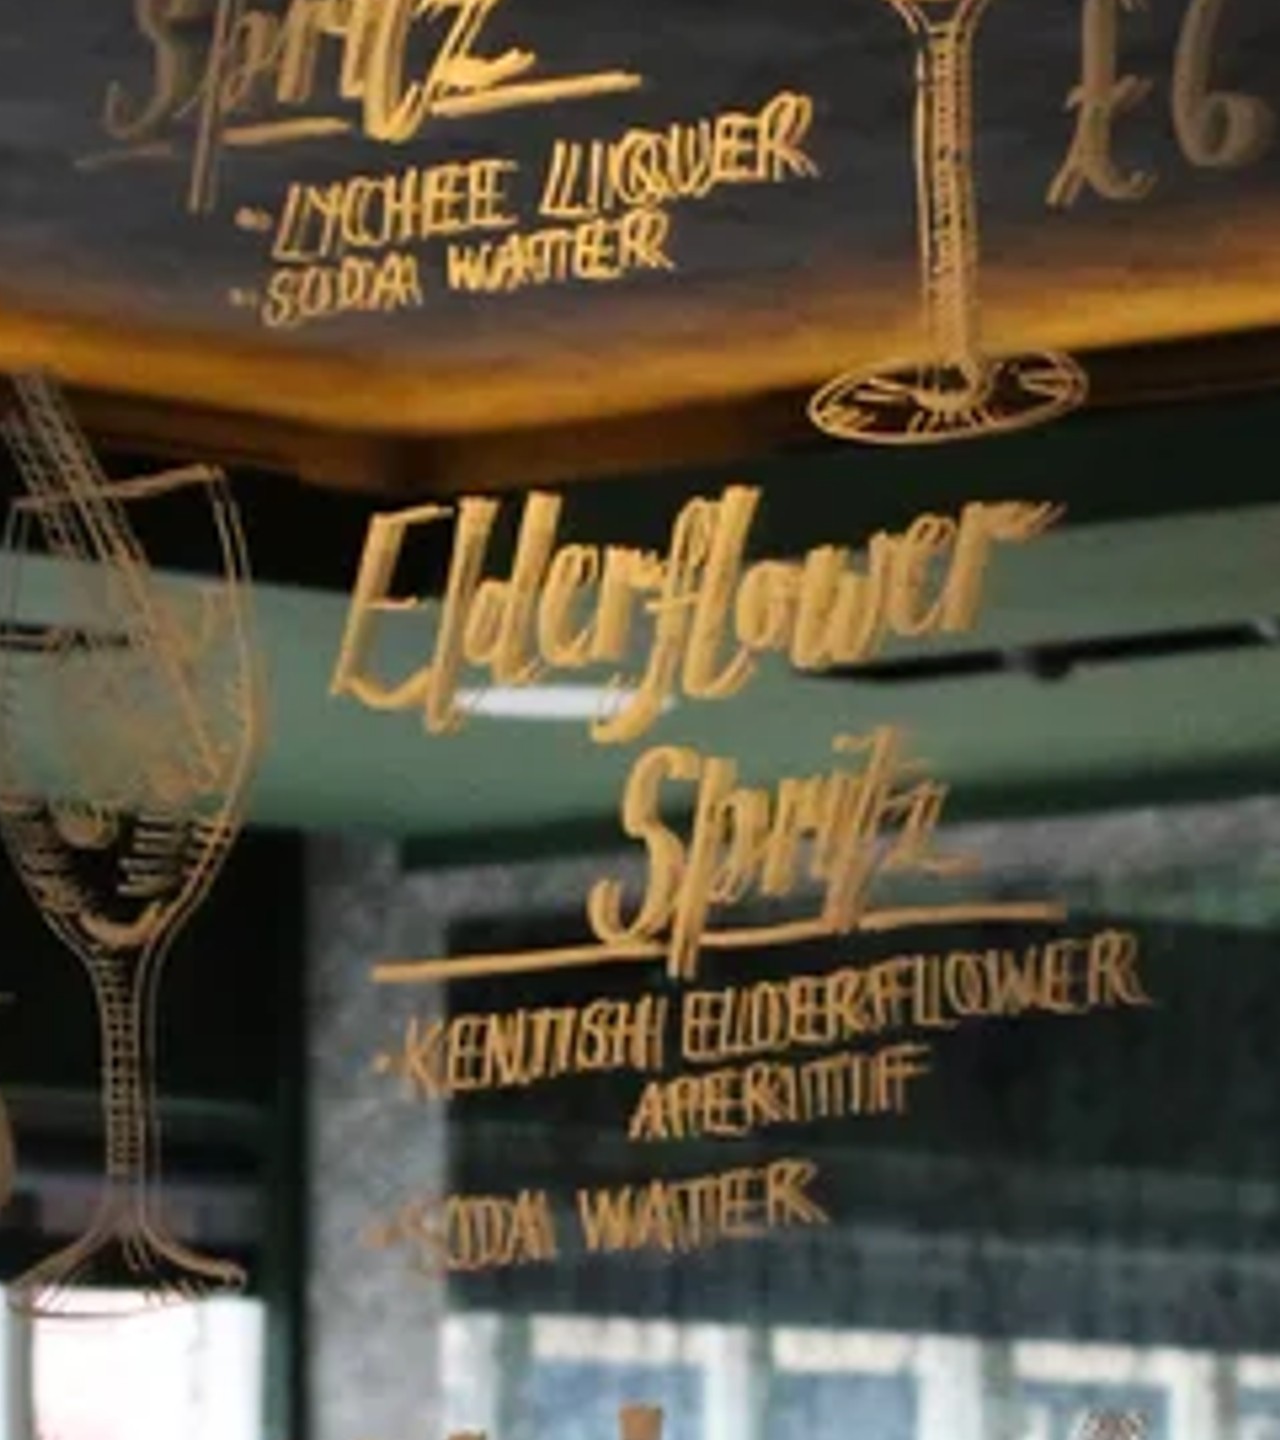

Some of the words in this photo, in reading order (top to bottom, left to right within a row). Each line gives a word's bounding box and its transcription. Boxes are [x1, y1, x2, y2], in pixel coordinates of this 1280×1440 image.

[263, 252, 422, 328] SODA
[446, 210, 674, 294] WATER
[272, 158, 517, 262] LYCHEE
[331, 485, 1067, 742] Elderflower
[587, 725, 982, 980] Spritz
[400, 996, 666, 1102] KENTISH
[681, 930, 1156, 1062] ELDERFLOWER
[400, 1186, 558, 1277] SODA
